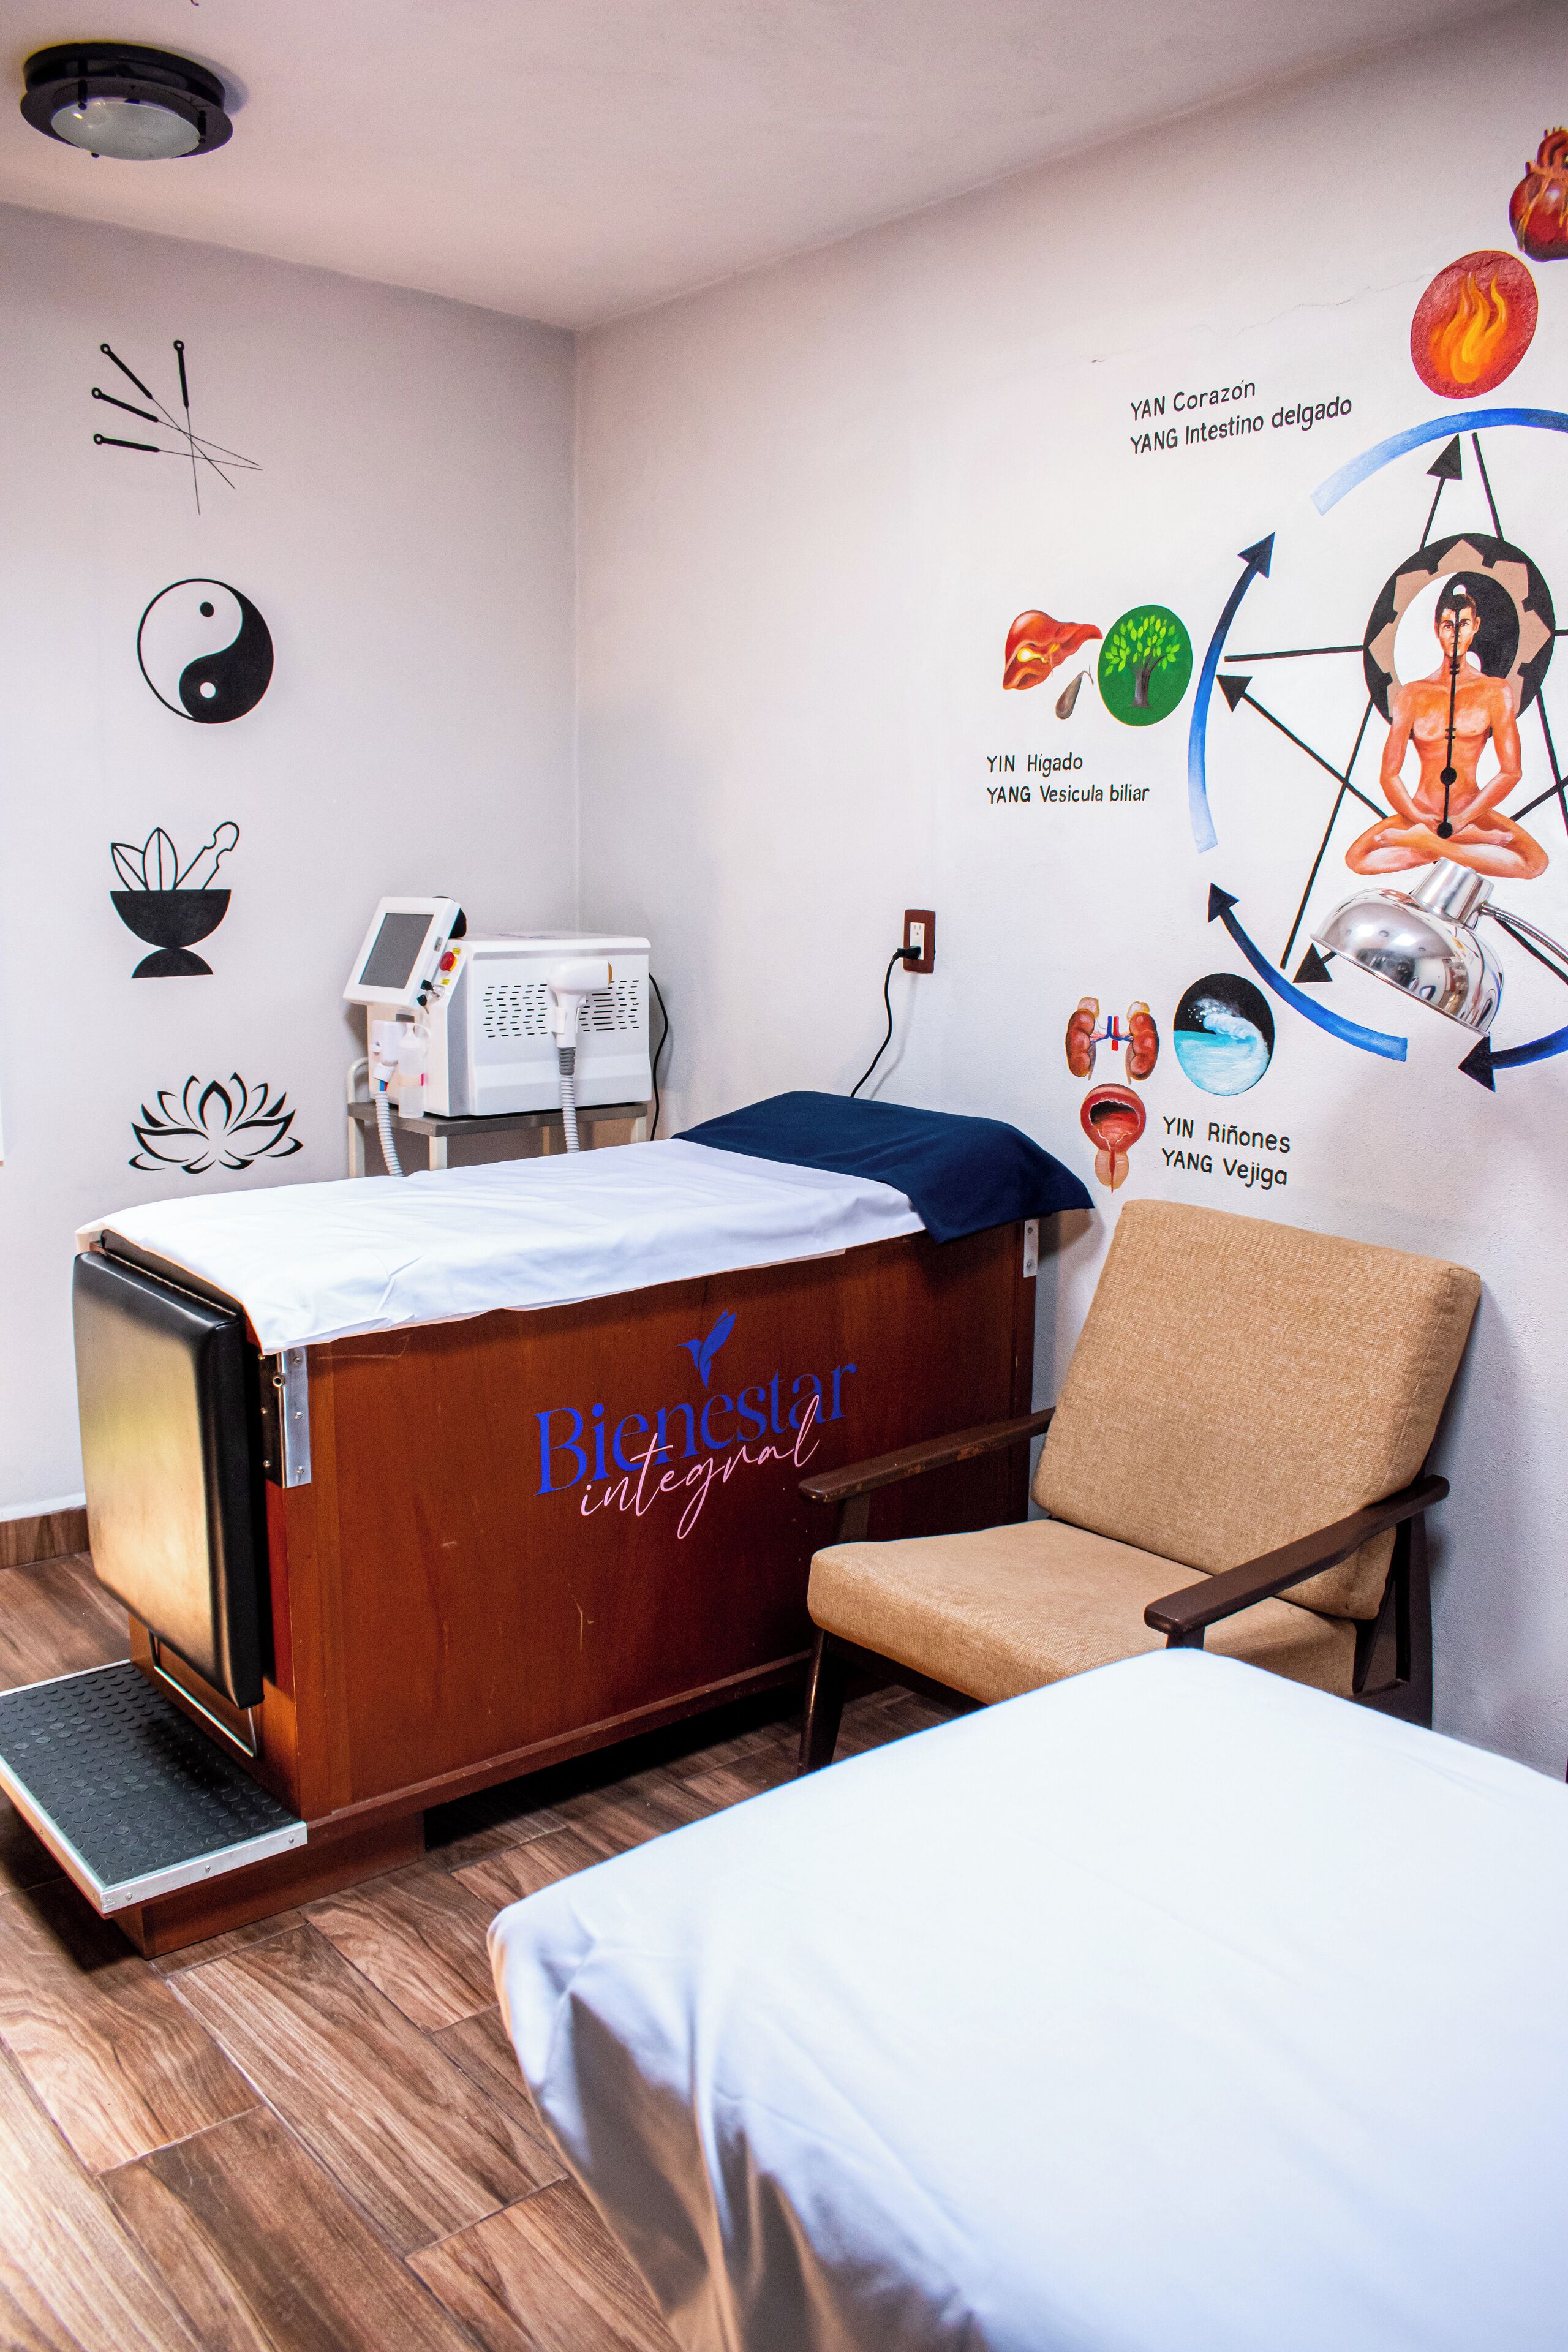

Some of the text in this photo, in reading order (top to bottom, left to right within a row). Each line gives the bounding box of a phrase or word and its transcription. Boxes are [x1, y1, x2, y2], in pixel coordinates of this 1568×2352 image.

[1130, 378, 1256, 421] YAN Corazón
[1130, 395, 1352, 454] YANG Intestino delgado
[987, 752, 1084, 778] YIN Hígado
[987, 783, 1150, 804] YANG Vesicula biliar
[1163, 1115, 1291, 1154] YIN Riñones
[1161, 1147, 1288, 1191] YANG Vejiga
[533, 1363, 858, 1497] Bienestar
[581, 1394, 820, 1540] integral
